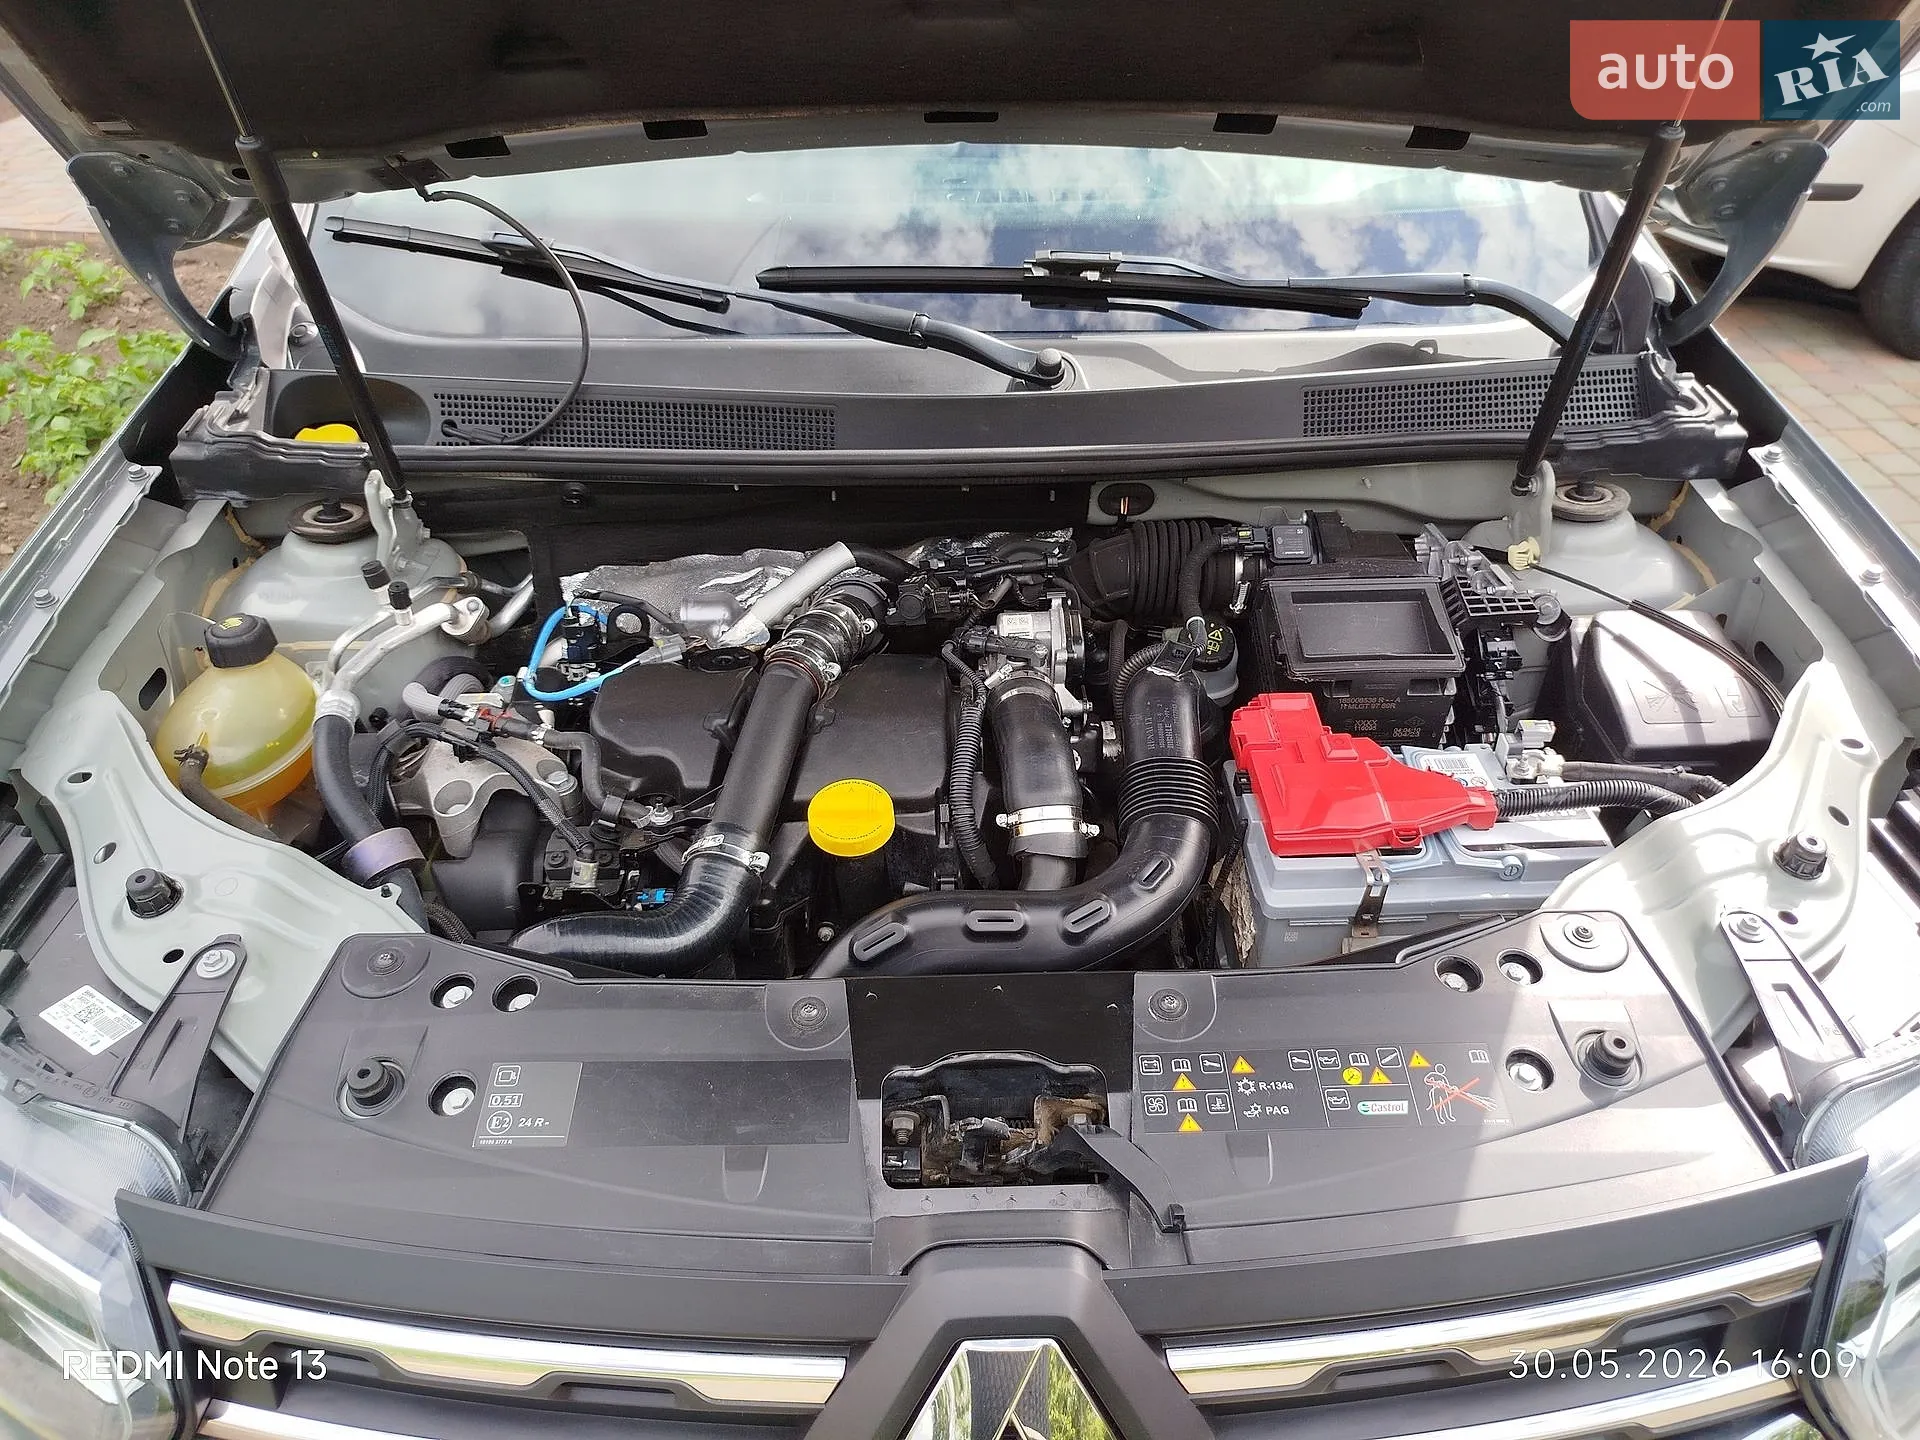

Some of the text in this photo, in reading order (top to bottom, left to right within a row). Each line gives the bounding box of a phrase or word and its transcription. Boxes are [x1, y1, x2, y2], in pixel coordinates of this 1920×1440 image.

[1258, 1081, 1294, 1091] R-134a
[491, 1095, 519, 1106] 0,51
[1265, 1105, 1290, 1115] PAG
[1370, 1101, 1406, 1113] Castrol
